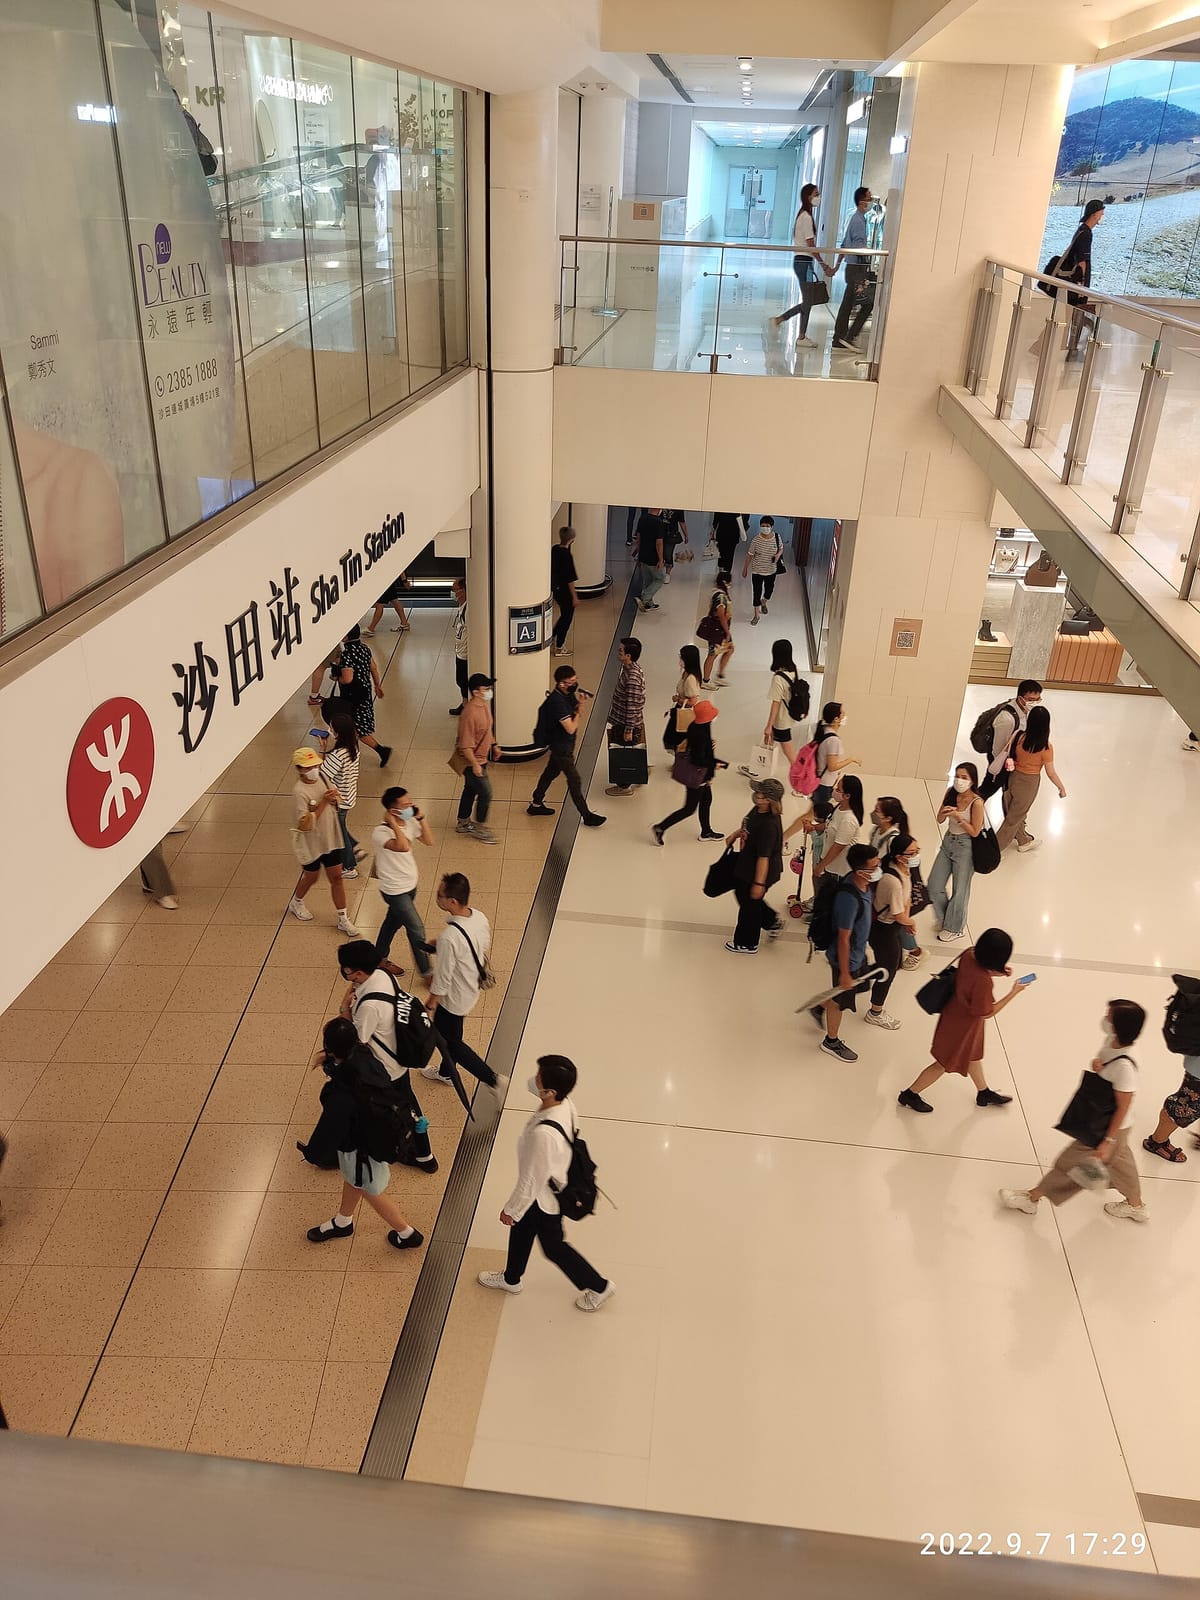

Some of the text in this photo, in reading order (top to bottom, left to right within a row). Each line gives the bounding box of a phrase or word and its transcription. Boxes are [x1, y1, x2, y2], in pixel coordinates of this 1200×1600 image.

[147, 300, 214, 339] 永遠年輕
[30, 329, 60, 350] Sammi
[166, 358, 218, 393] 2385 1888
[310, 511, 406, 624] Sha Tin Station
[171, 567, 303, 754] 沙田站
